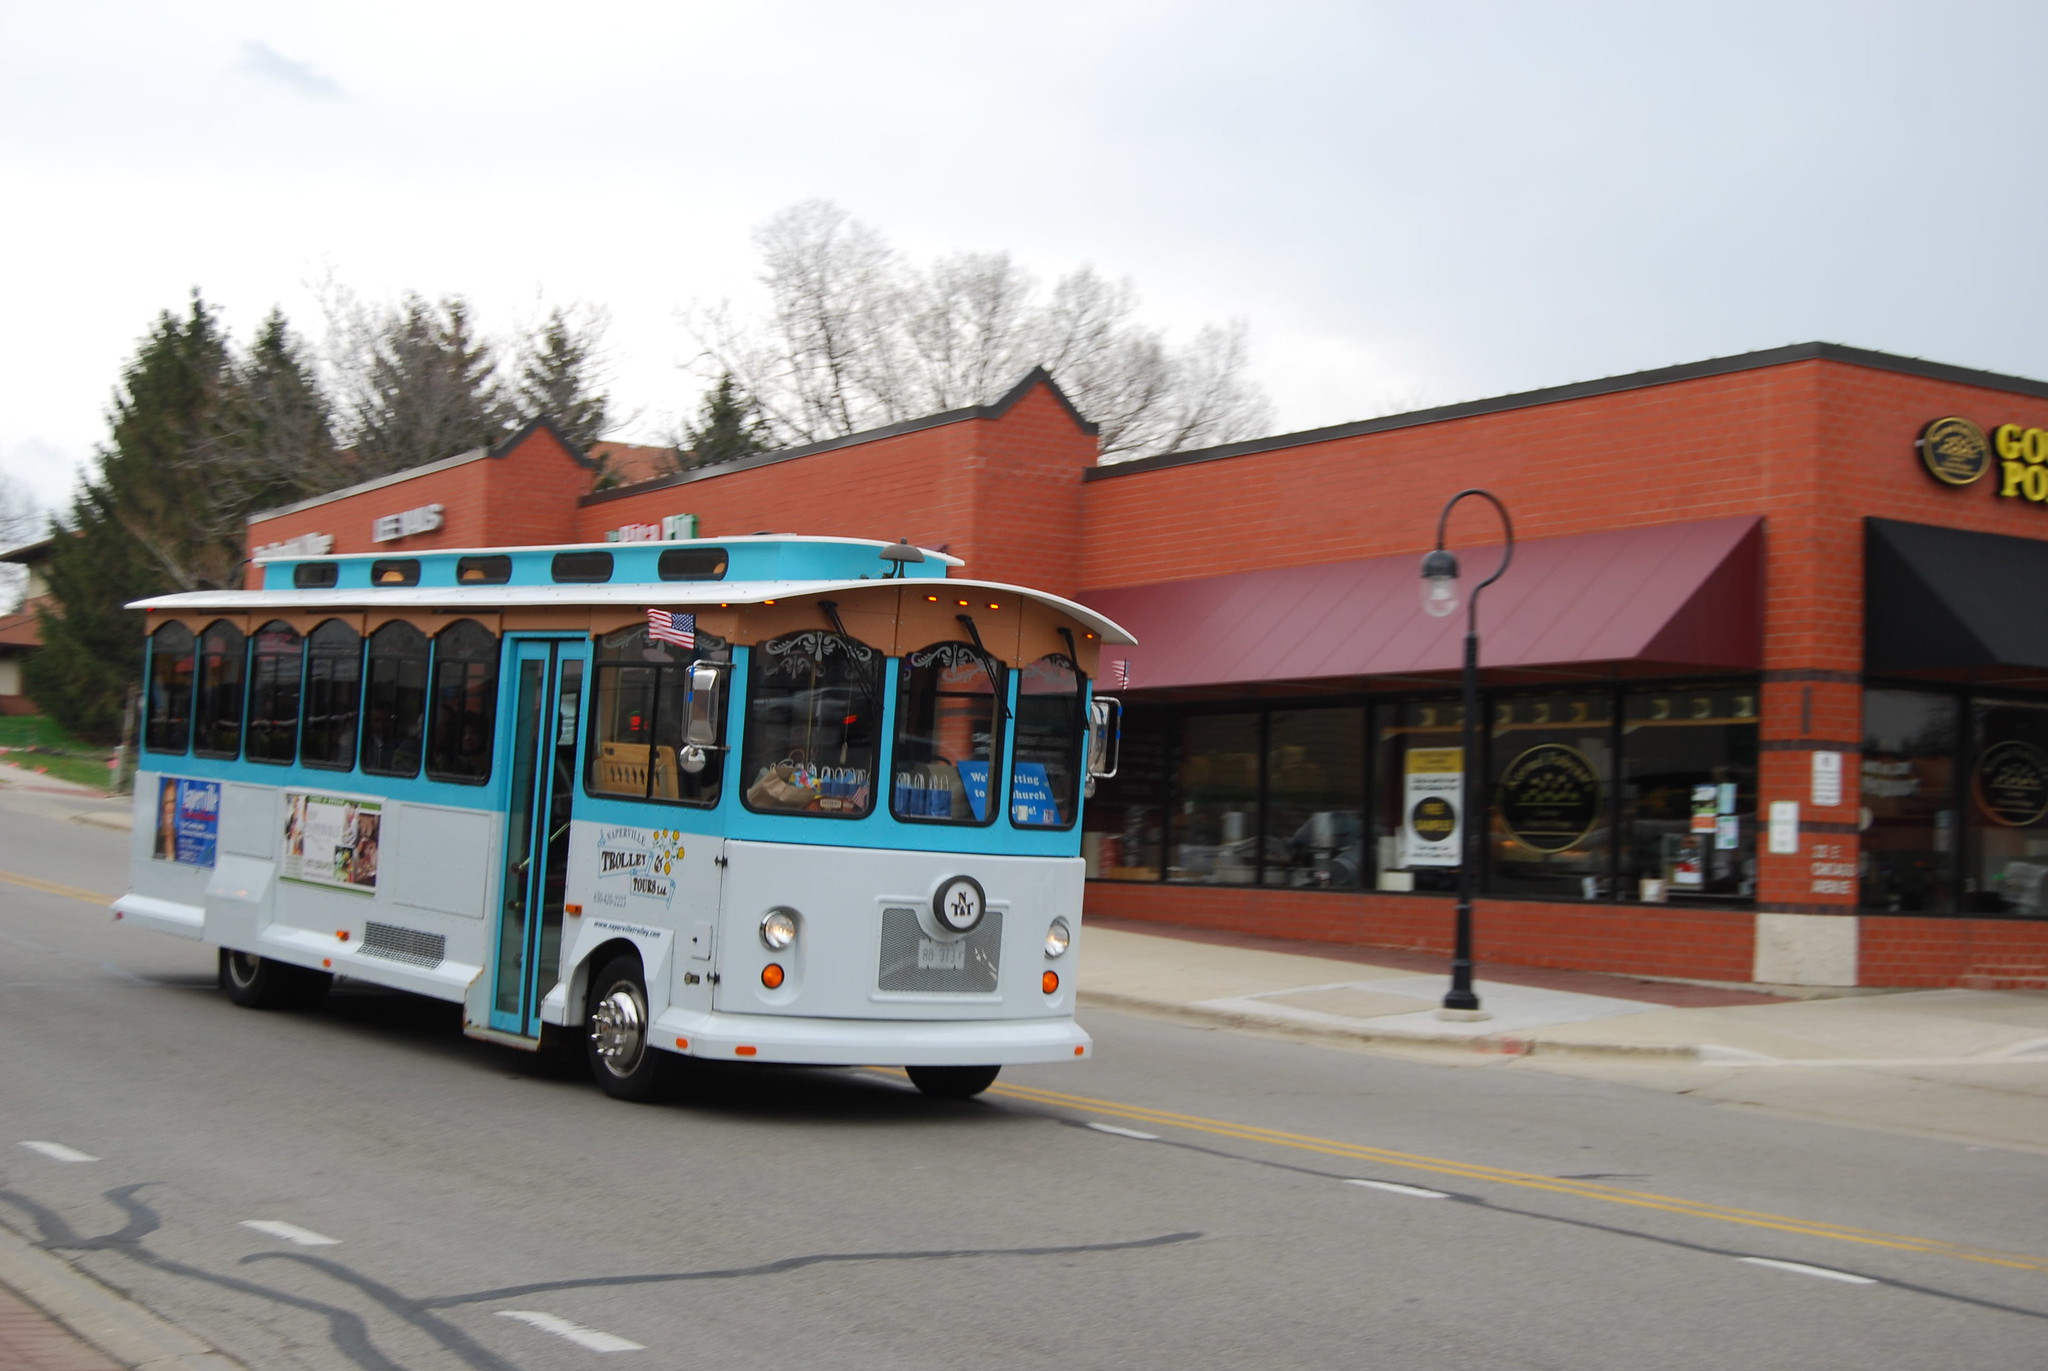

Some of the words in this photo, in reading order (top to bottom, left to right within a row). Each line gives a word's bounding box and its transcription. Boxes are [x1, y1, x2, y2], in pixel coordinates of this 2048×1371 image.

[1995, 423, 2048, 464] GO
[2000, 461, 2048, 501] PO
[970, 772, 989, 783] We'
[1014, 774, 1039, 786] tting
[974, 788, 985, 798] to
[1012, 805, 1037, 815] te!
[601, 851, 647, 872] TROLLEY
[632, 877, 657, 895] TOURS
[958, 891, 967, 904] N
